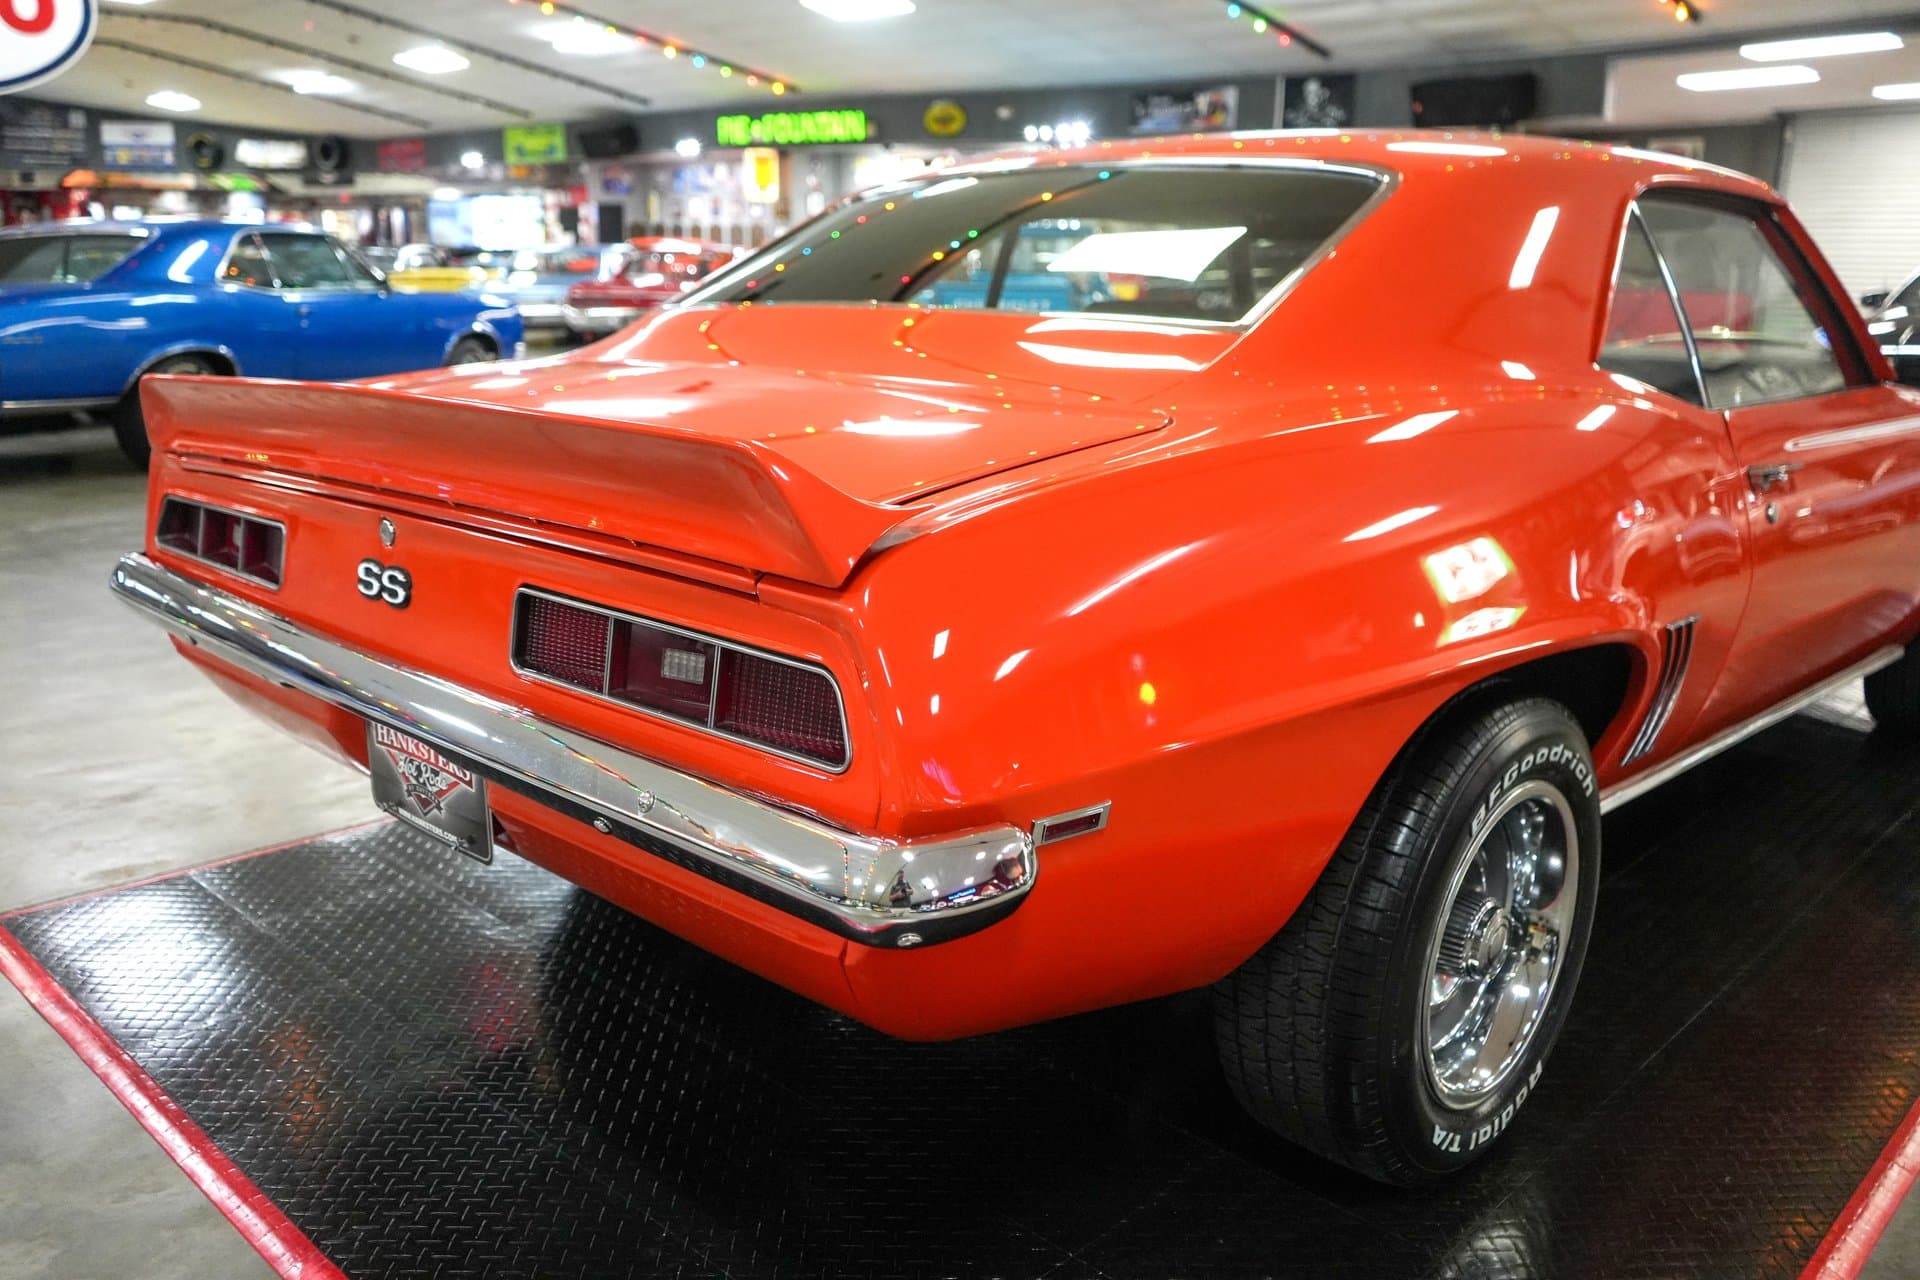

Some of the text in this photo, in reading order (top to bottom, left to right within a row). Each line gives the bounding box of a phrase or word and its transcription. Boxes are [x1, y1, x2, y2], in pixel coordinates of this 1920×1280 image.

[357, 559, 411, 608] SS
[377, 722, 471, 781] HANKSTERS
[397, 755, 419, 777] Hot
[1471, 743, 1595, 836] BFGoodrich
[1432, 1060, 1543, 1153] Radial T/A
